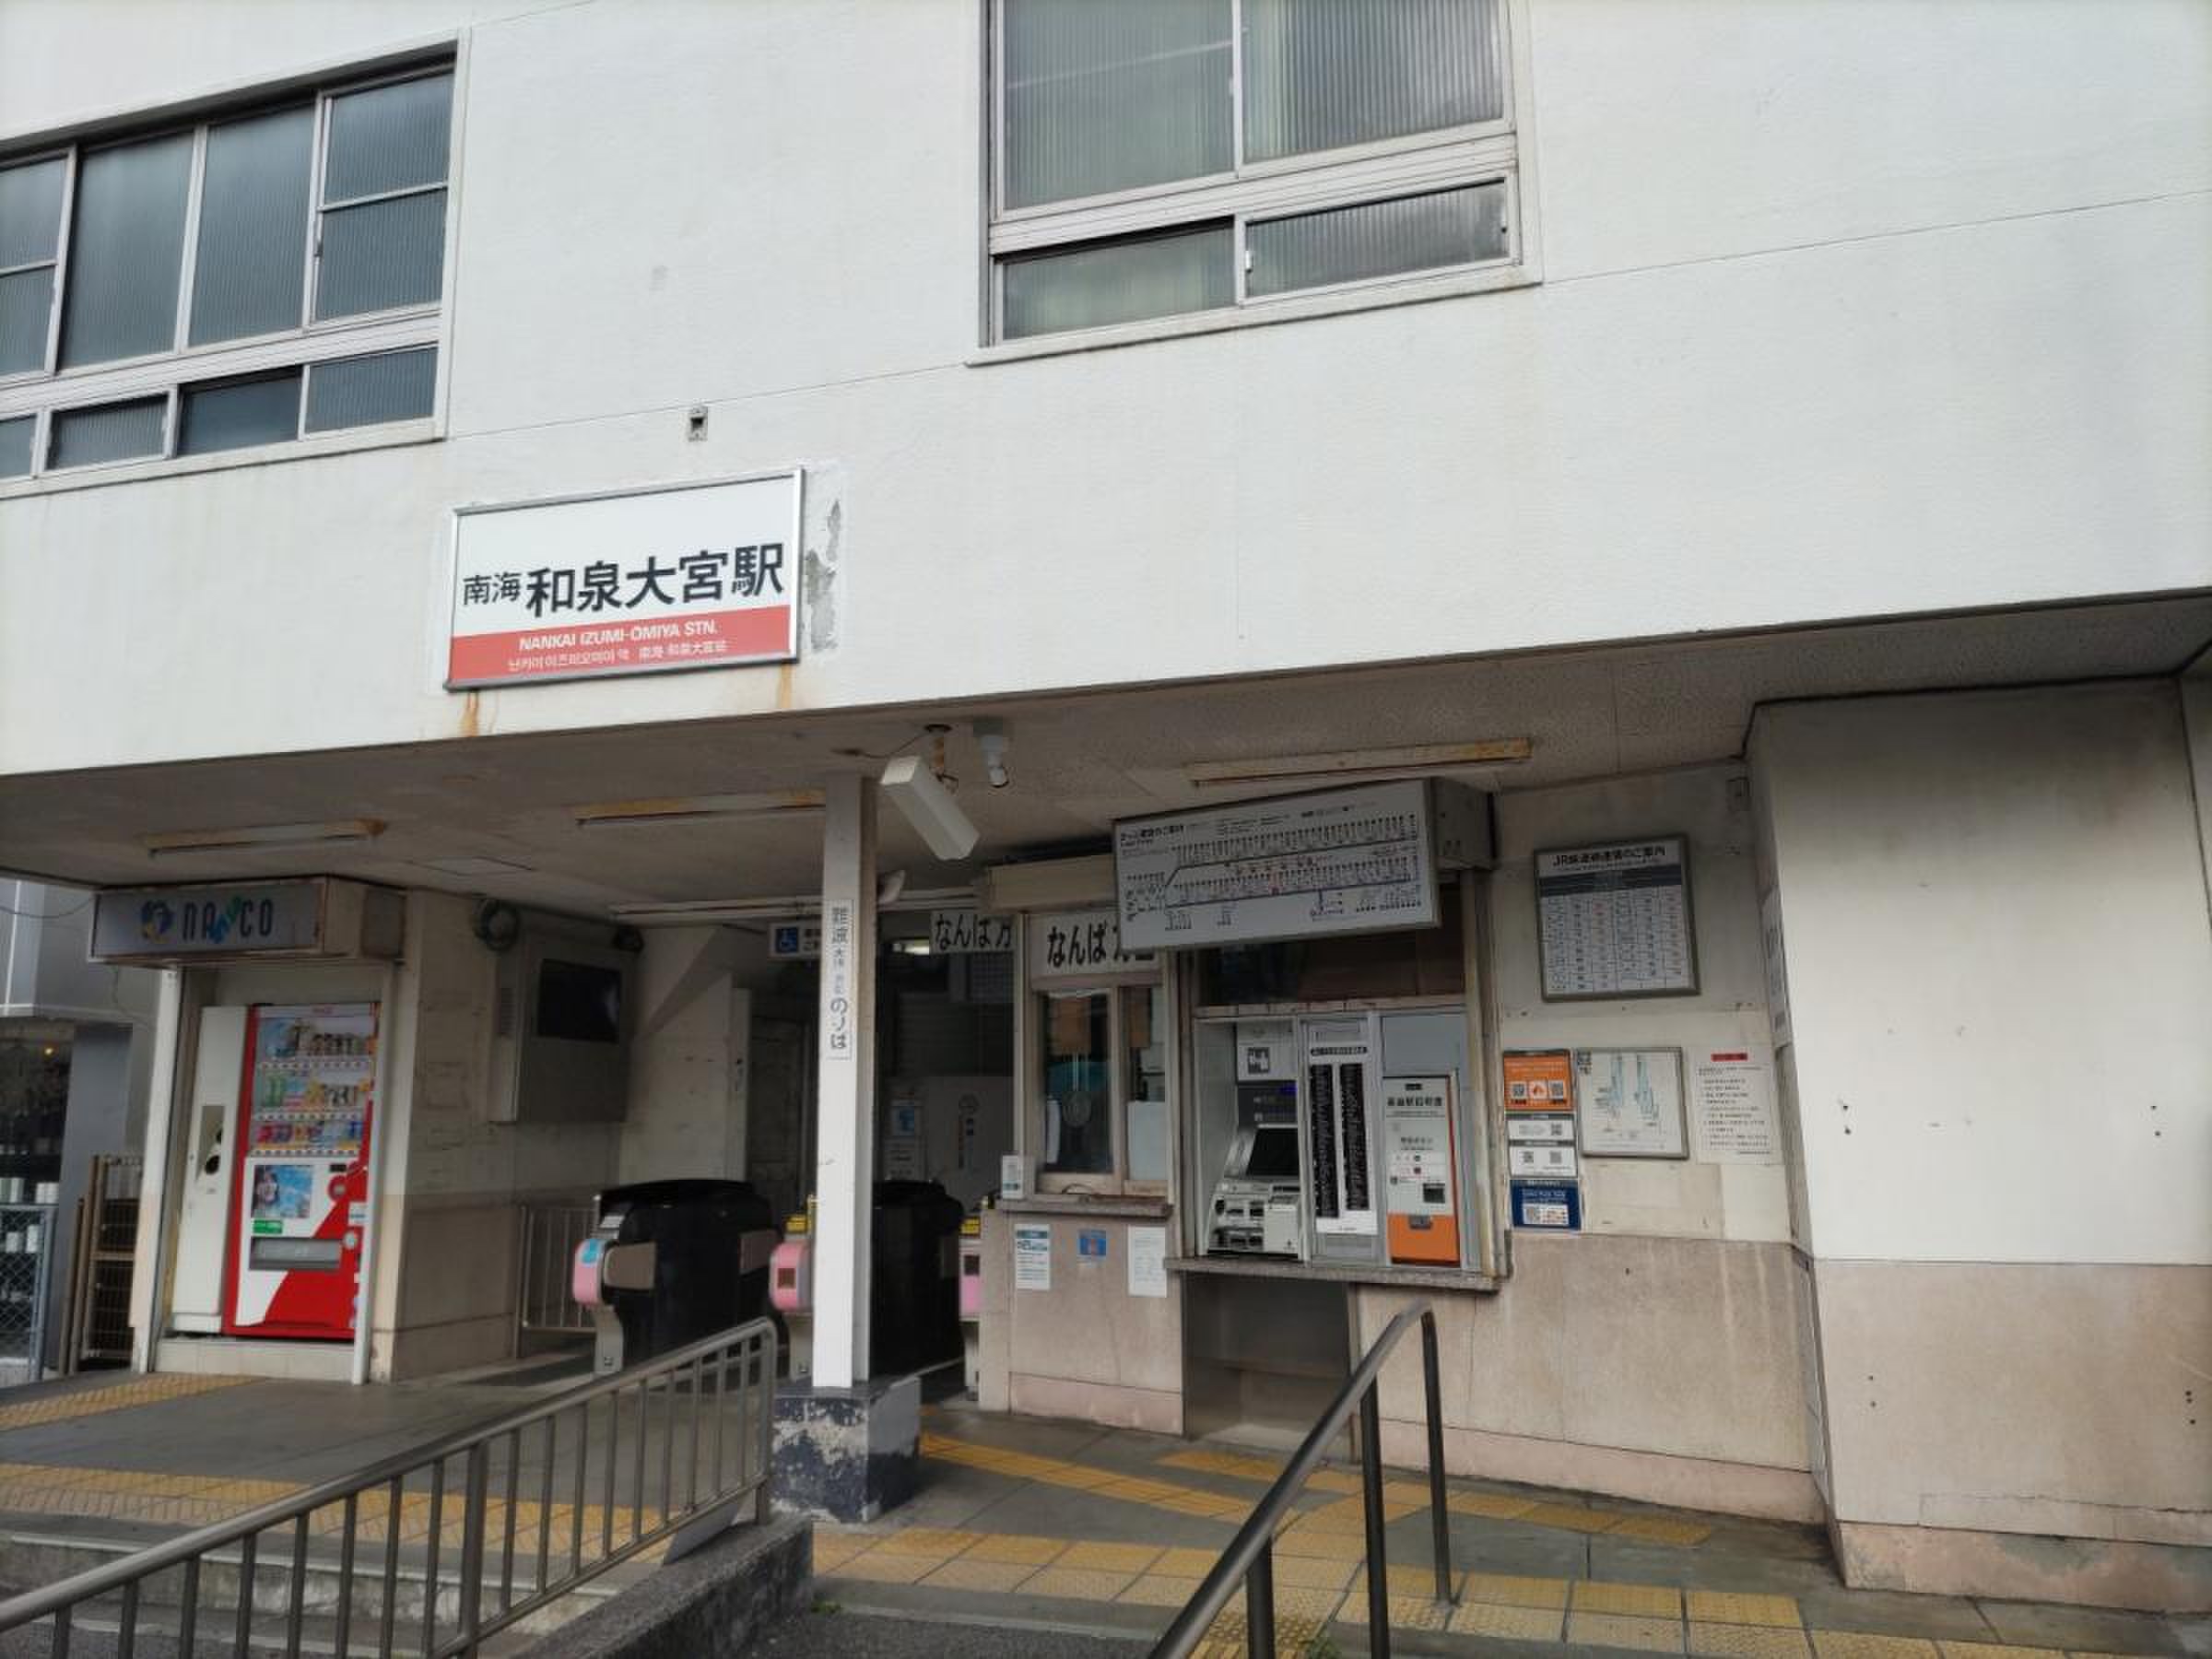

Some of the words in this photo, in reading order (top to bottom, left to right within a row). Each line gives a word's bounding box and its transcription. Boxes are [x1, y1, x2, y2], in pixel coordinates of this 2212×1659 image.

[463, 571, 522, 606] 南海
[525, 542, 785, 618] 和泉大宮駅
[520, 632, 576, 651] NANKAI
[579, 622, 680, 646] IZUMI-OMIYA
[684, 618, 719, 636] STN.
